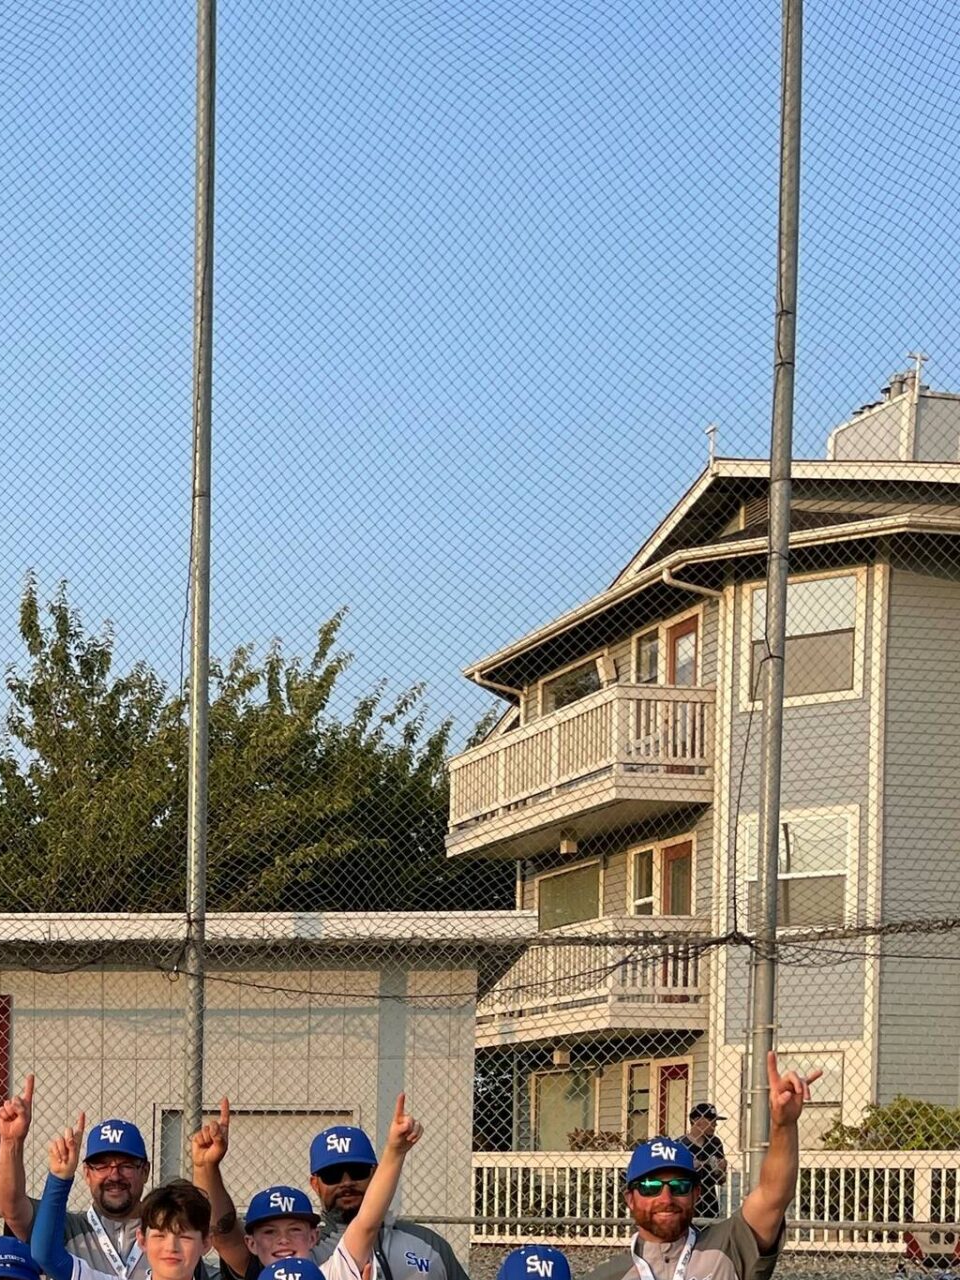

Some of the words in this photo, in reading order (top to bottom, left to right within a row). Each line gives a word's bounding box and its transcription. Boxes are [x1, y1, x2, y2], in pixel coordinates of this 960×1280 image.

[99, 1124, 124, 1144] SW
[326, 1133, 351, 1153] SW
[650, 1141, 678, 1162] SW
[269, 1191, 295, 1212] SW
[406, 1251, 430, 1273] SW
[525, 1254, 554, 1278] SW
